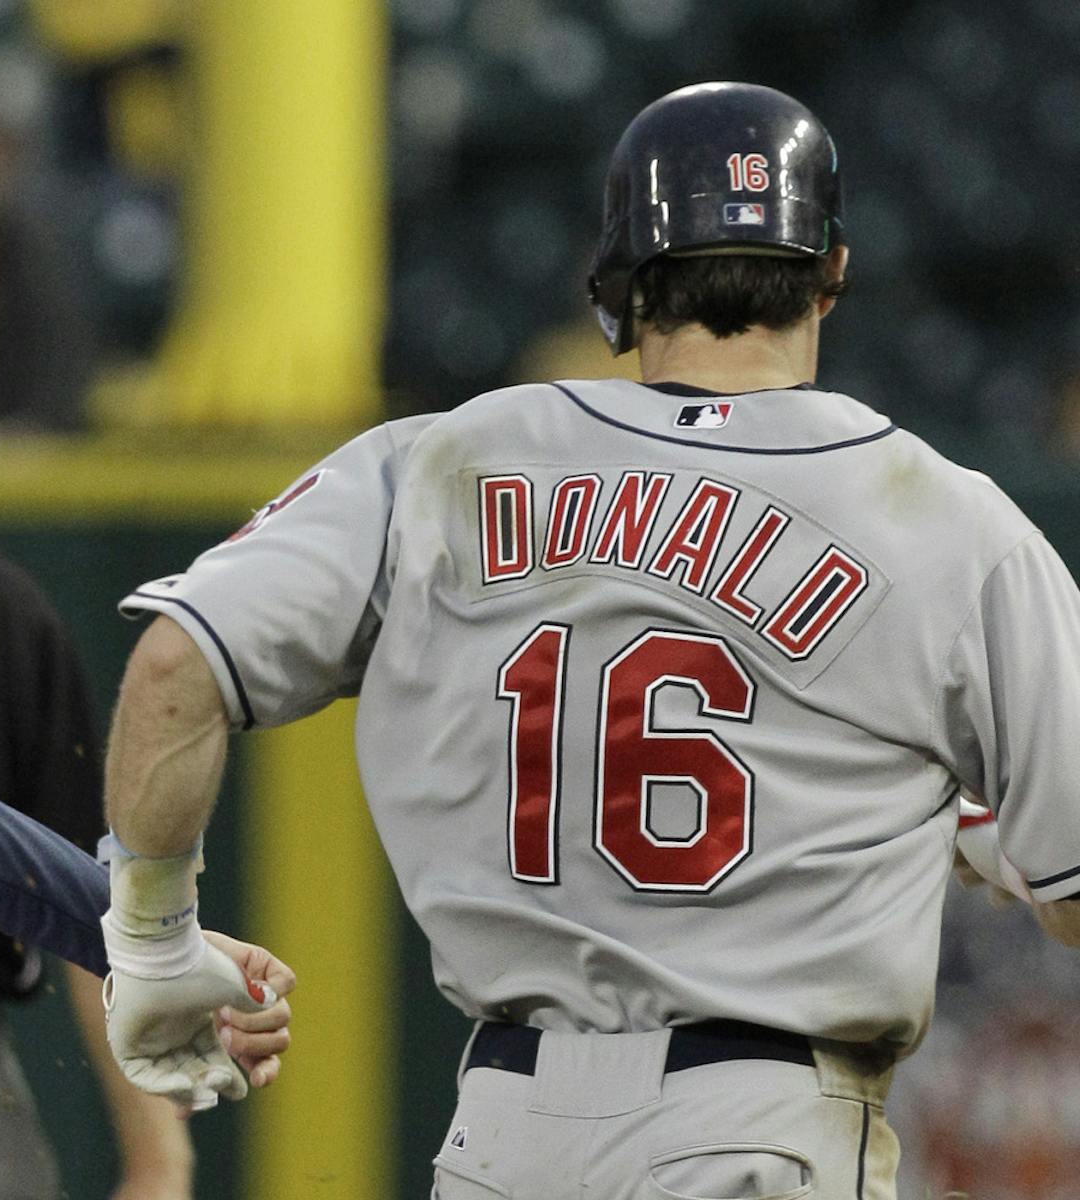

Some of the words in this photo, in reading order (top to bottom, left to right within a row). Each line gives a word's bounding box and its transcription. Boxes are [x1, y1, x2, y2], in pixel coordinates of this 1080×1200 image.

[726, 152, 770, 192] 16
[477, 470, 869, 662] DONALD
[495, 620, 758, 894] 16
